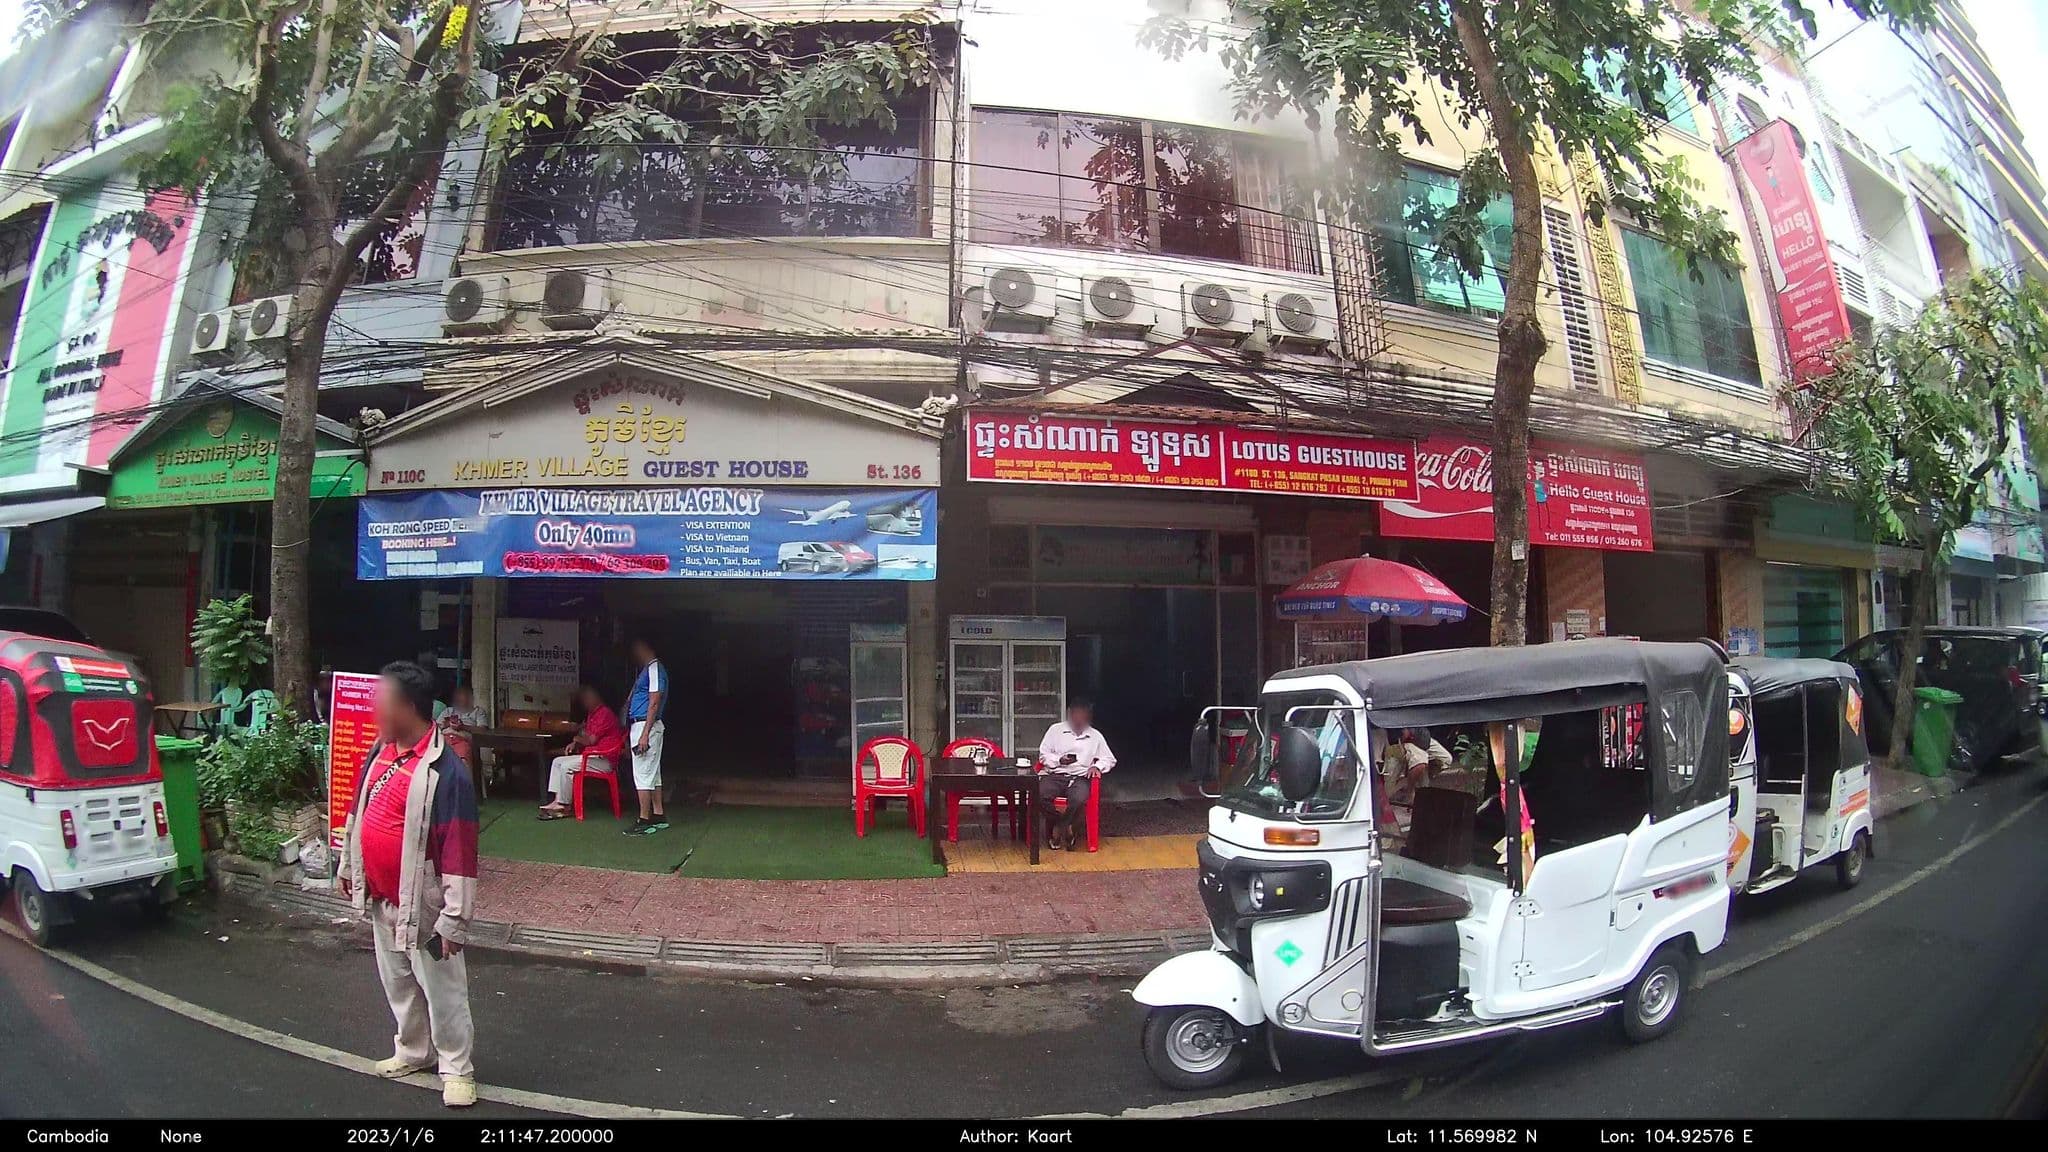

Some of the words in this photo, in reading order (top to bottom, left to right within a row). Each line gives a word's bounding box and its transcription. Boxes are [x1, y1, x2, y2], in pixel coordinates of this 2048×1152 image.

[1782, 235, 1815, 260] HELLO
[1232, 440, 1291, 462] LOTUS
[1298, 445, 1407, 471] GUESTHOUSE
[232, 468, 269, 483] HOSTEL
[454, 459, 528, 481] KHMER
[536, 456, 628, 478] VILLAGE
[643, 460, 720, 479] GUEST
[727, 460, 809, 479] HOUSE
[866, 464, 889, 480] St.
[892, 464, 922, 480] 136
[397, 469, 426, 484] 110C
[1249, 479, 1263, 489] TEL:
[1291, 482, 1300, 490] 12
[480, 488, 537, 515] KHMER
[540, 488, 611, 515] VILLAGE
[611, 488, 684, 515] TRAVEL
[684, 487, 763, 515] AGENCY
[1549, 483, 1580, 498] Hello
[1582, 486, 1613, 501] Guest
[1615, 491, 1647, 505] House
[369, 523, 391, 536] KOH
[391, 522, 420, 535] RONG
[422, 519, 450, 533] SPEED
[685, 521, 704, 530] VISA
[705, 521, 751, 530] EXTENTION
[538, 522, 580, 547] Only
[685, 533, 704, 541] VISA
[705, 533, 714, 542] to
[715, 533, 749, 542] Vietnam
[1559, 533, 1571, 541] 011
[1572, 533, 1585, 542] 555
[1604, 536, 1616, 545] 015
[382, 538, 425, 550] BOOKING
[685, 545, 704, 553] VISA
[705, 545, 714, 553] to
[715, 545, 750, 554] Thailand
[685, 556, 702, 566] Bus,
[703, 557, 721, 567] Van,
[722, 557, 740, 567] Taxi,
[742, 557, 761, 566] Boat
[680, 568, 697, 577] Plan
[752, 568, 761, 577] in
[762, 568, 782, 577] Here
[1296, 581, 1340, 591] ANCHOR
